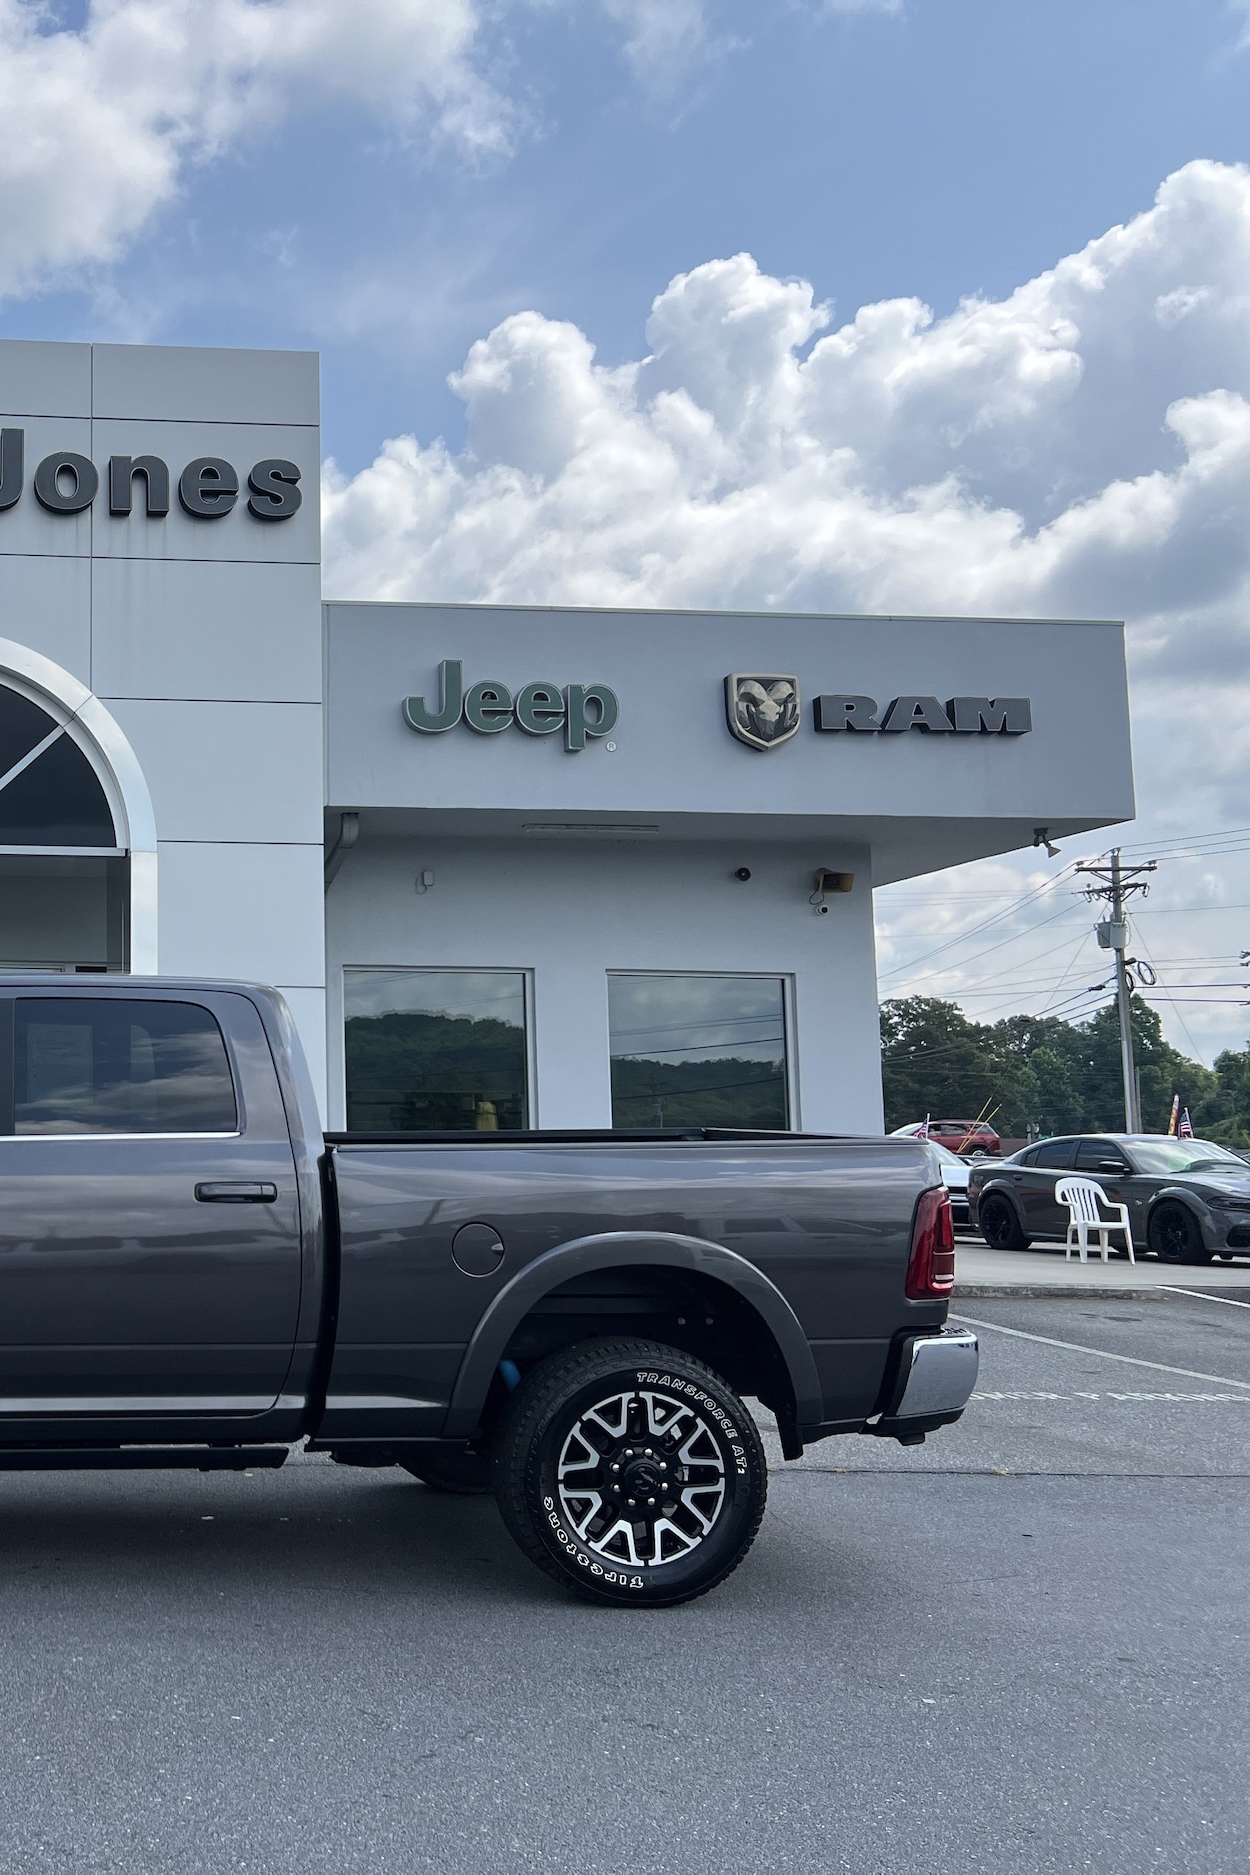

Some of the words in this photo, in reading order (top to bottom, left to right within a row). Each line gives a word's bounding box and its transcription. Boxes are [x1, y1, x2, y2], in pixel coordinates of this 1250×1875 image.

[402, 660, 620, 753] Jeep
[812, 694, 1033, 734] RAM
[636, 1372, 739, 1439] TRANSFORCE
[543, 1496, 644, 1589] Firestone
